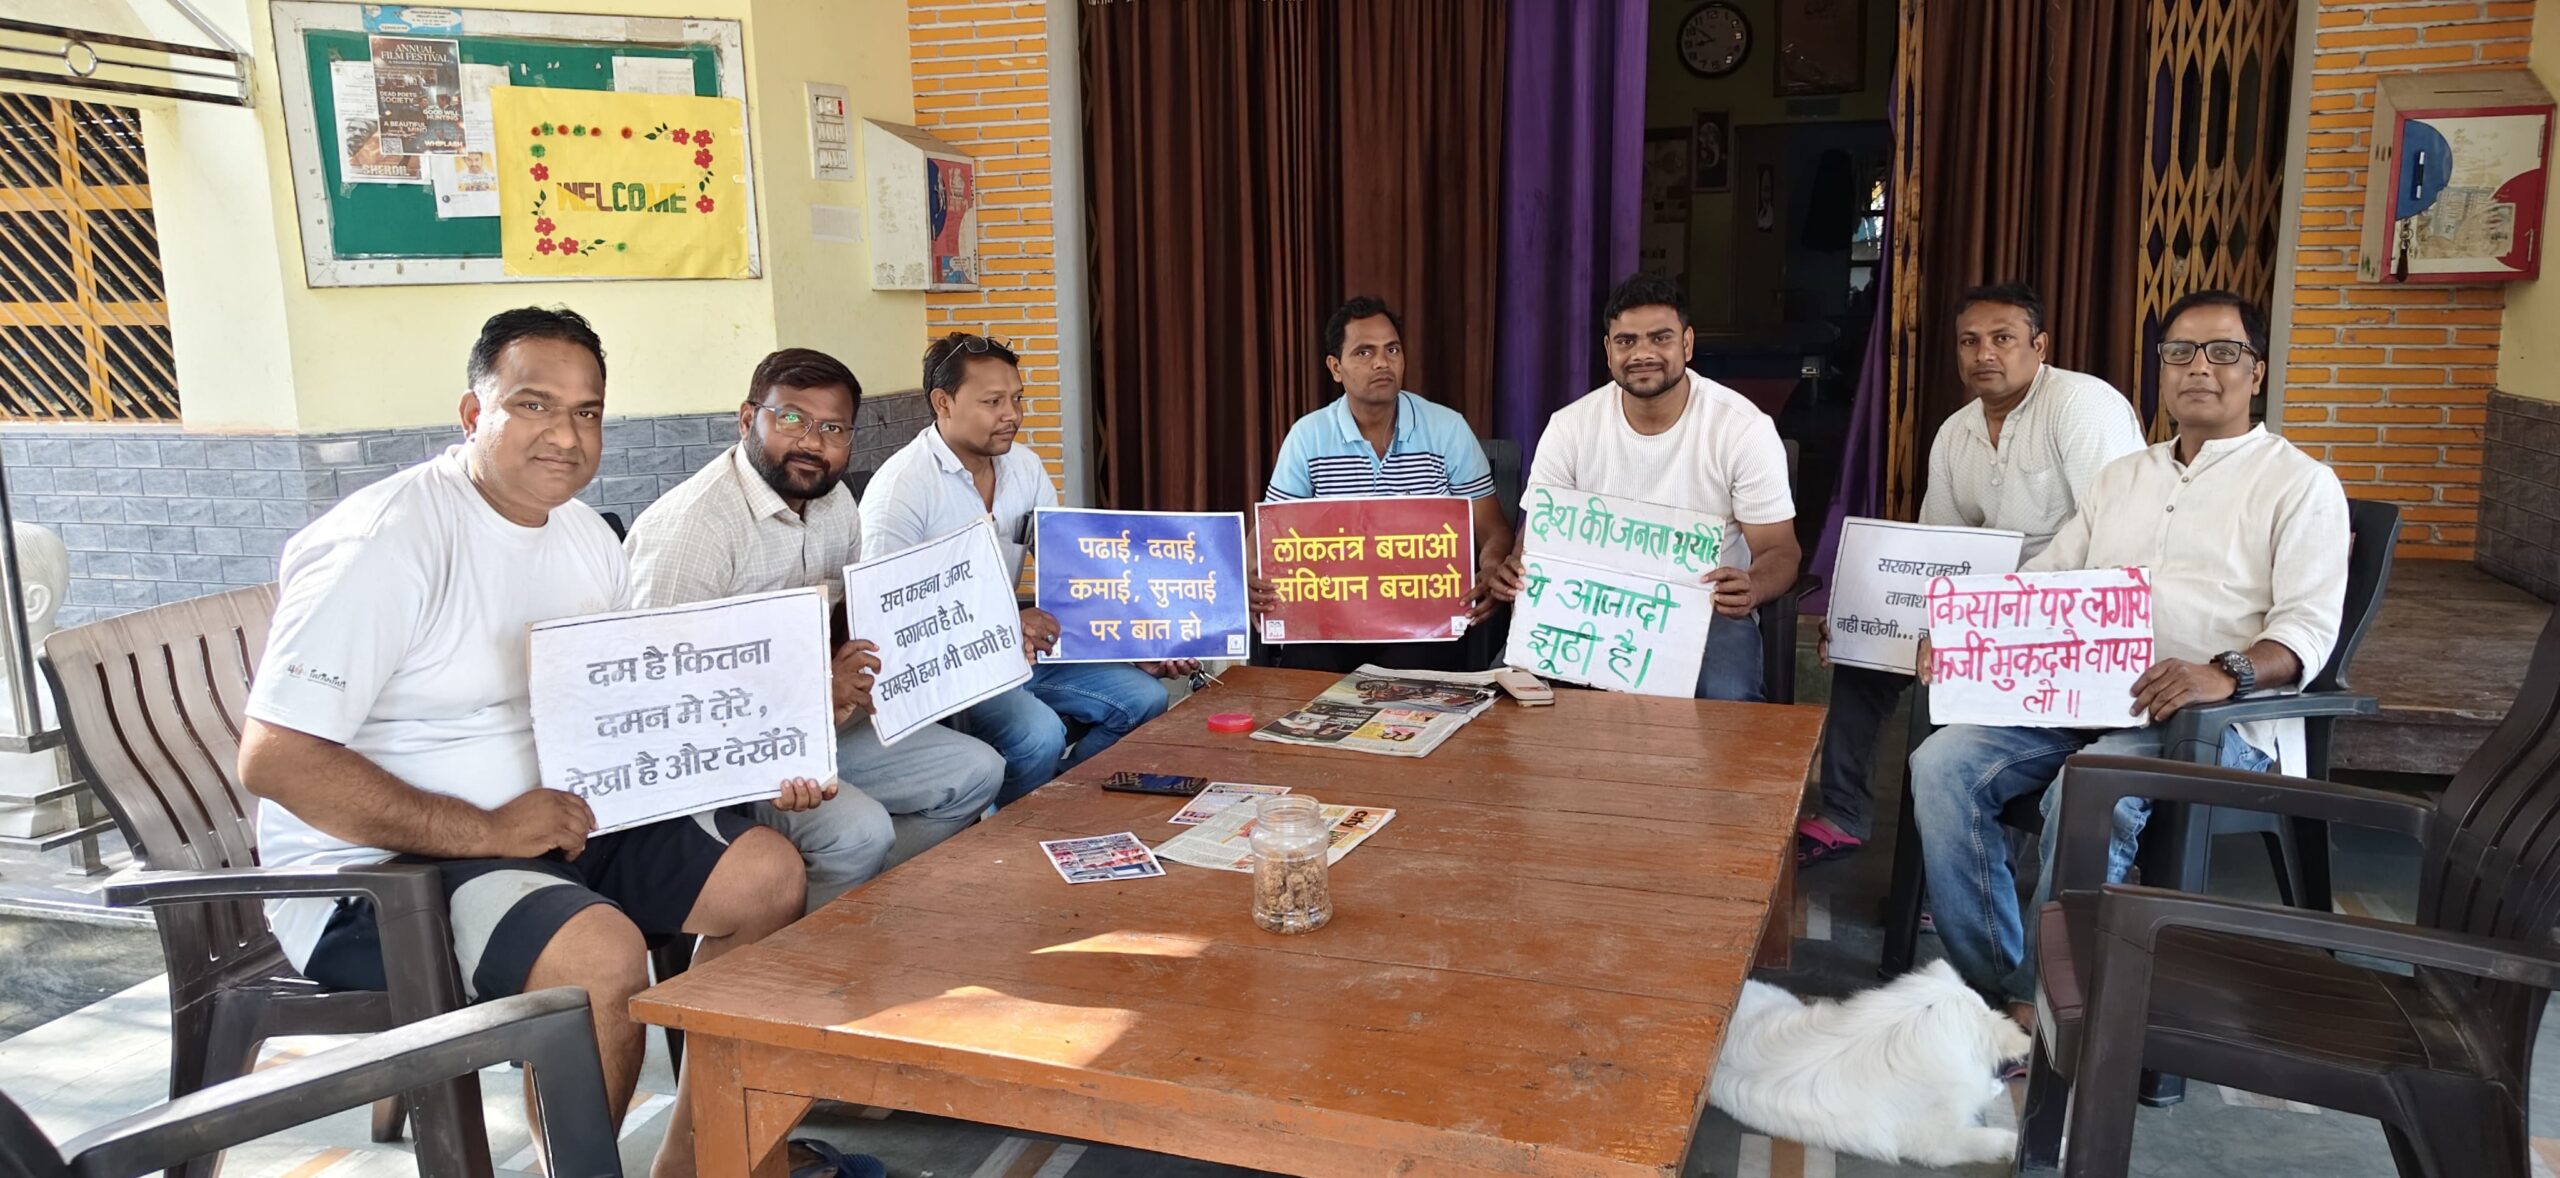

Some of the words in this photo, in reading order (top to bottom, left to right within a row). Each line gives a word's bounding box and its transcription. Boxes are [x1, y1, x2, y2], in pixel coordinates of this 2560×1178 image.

[381, 51, 404, 60] FILM
[406, 53, 450, 62] FESTIVAL
[395, 44, 435, 53] ANNUAL
[362, 165, 410, 176] SHERDIL
[556, 182, 687, 213] WELCOME
[1272, 527, 1365, 562] लोकतंत्र
[1374, 523, 1458, 560] बचाओ
[1531, 488, 1579, 542] देश
[1579, 496, 1614, 548] की
[1610, 517, 1675, 560] जनता
[1147, 531, 1205, 565] दवाई,
[1878, 558, 1926, 575] सरकार
[1926, 561, 1971, 577] तम्हारी
[880, 588, 904, 613] सच
[906, 573, 941, 602] कहना
[944, 560, 973, 588] अगर
[1069, 570, 1140, 605] कमाई,
[1147, 571, 1216, 608] सुनवाई
[1271, 567, 1369, 603] संविधान
[1378, 563, 1462, 600] बचाओ
[1526, 563, 1551, 607] ये
[1556, 579, 1681, 633] आजादी
[1885, 591, 1927, 608] तानाश
[2040, 588, 2082, 628] पर
[2081, 568, 2151, 628] लगाये
[894, 615, 939, 648] बगावत
[937, 605, 951, 631] है
[949, 600, 975, 625] तो,
[1089, 619, 1122, 641] पर
[1130, 619, 1172, 641] बात
[1178, 611, 1202, 642] हो
[1837, 614, 1859, 633] नही
[587, 657, 638, 687] दम
[642, 646, 669, 681] है
[672, 638, 772, 676] कितना
[878, 663, 919, 702] समझो
[917, 657, 940, 683] हम
[944, 643, 962, 670] भी
[960, 629, 1000, 661] बागी
[1930, 630, 1996, 684] फर्जी
[1989, 629, 2087, 691] मुकदमे
[2085, 637, 2153, 673] वापस
[2022, 678, 2061, 714] लो
[595, 705, 670, 738] दमन
[675, 694, 703, 723] मे
[565, 763, 631, 799] देखा
[635, 751, 660, 786] है
[665, 743, 721, 780] और
[724, 727, 808, 766] देखेंगे
